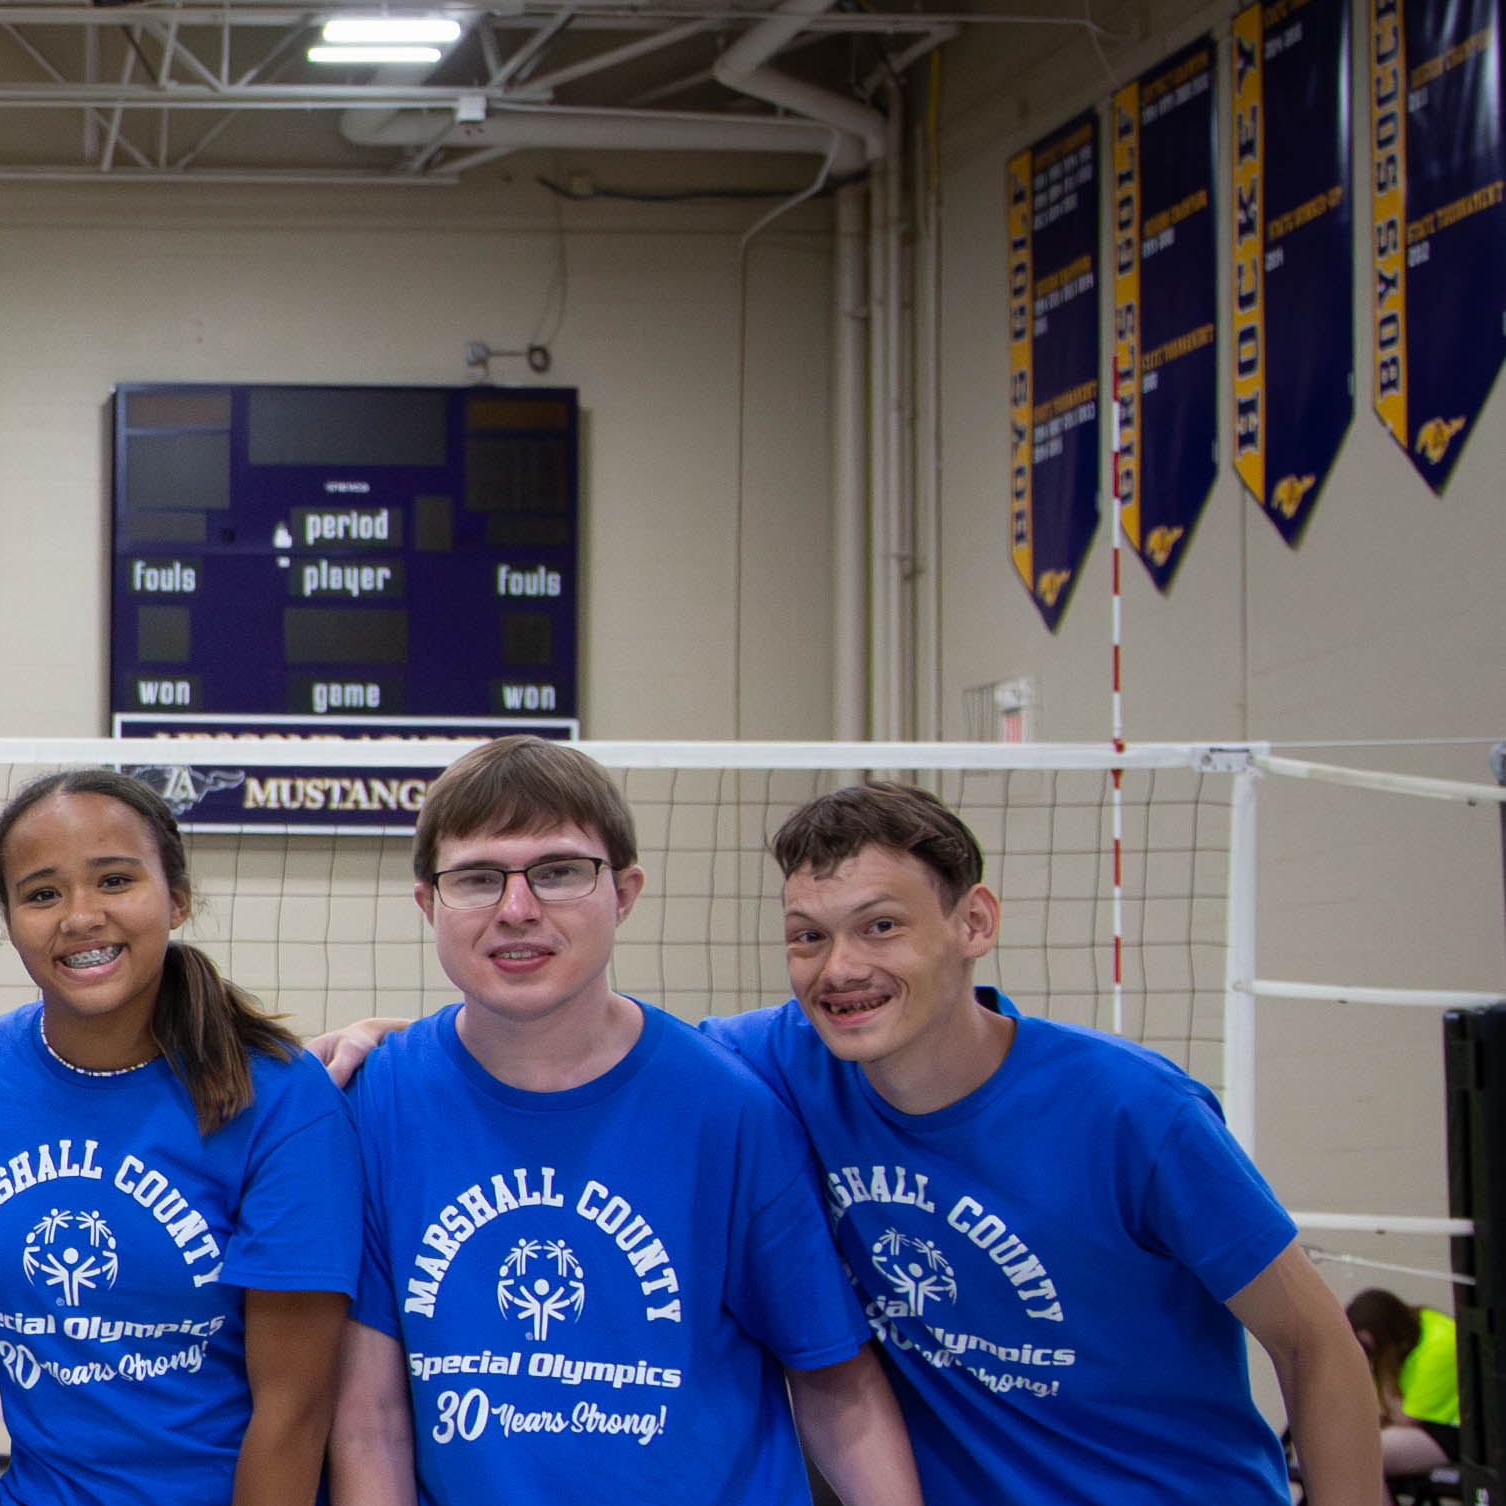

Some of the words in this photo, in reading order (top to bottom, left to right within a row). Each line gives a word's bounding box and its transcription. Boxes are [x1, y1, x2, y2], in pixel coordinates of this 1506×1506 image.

[1235, 35, 1260, 457] HOCKEY
[1374, 215, 1401, 400] BOYS
[305, 509, 389, 543] period
[134, 561, 196, 592] fouls
[304, 561, 391, 596] player
[498, 565, 561, 596] fouls
[138, 680, 190, 704] won
[313, 683, 380, 712] game
[503, 685, 555, 710] won
[245, 777, 434, 810] MUSTANG
[114, 1154, 224, 1288] COUNTY
[405, 1167, 564, 1318] MARSHALL
[576, 1180, 681, 1322] COUNTY
[827, 1166, 935, 1219] SHALL
[947, 1196, 1064, 1322] COUNTY
[64, 1315, 226, 1343] Olympics
[39, 1361, 117, 1386] Years
[118, 1340, 208, 1382] Strong!
[409, 1351, 521, 1380] Special
[528, 1353, 681, 1388] Olympics
[432, 1388, 490, 1444] 30
[491, 1403, 570, 1438] Years
[571, 1401, 667, 1446] Strong!
